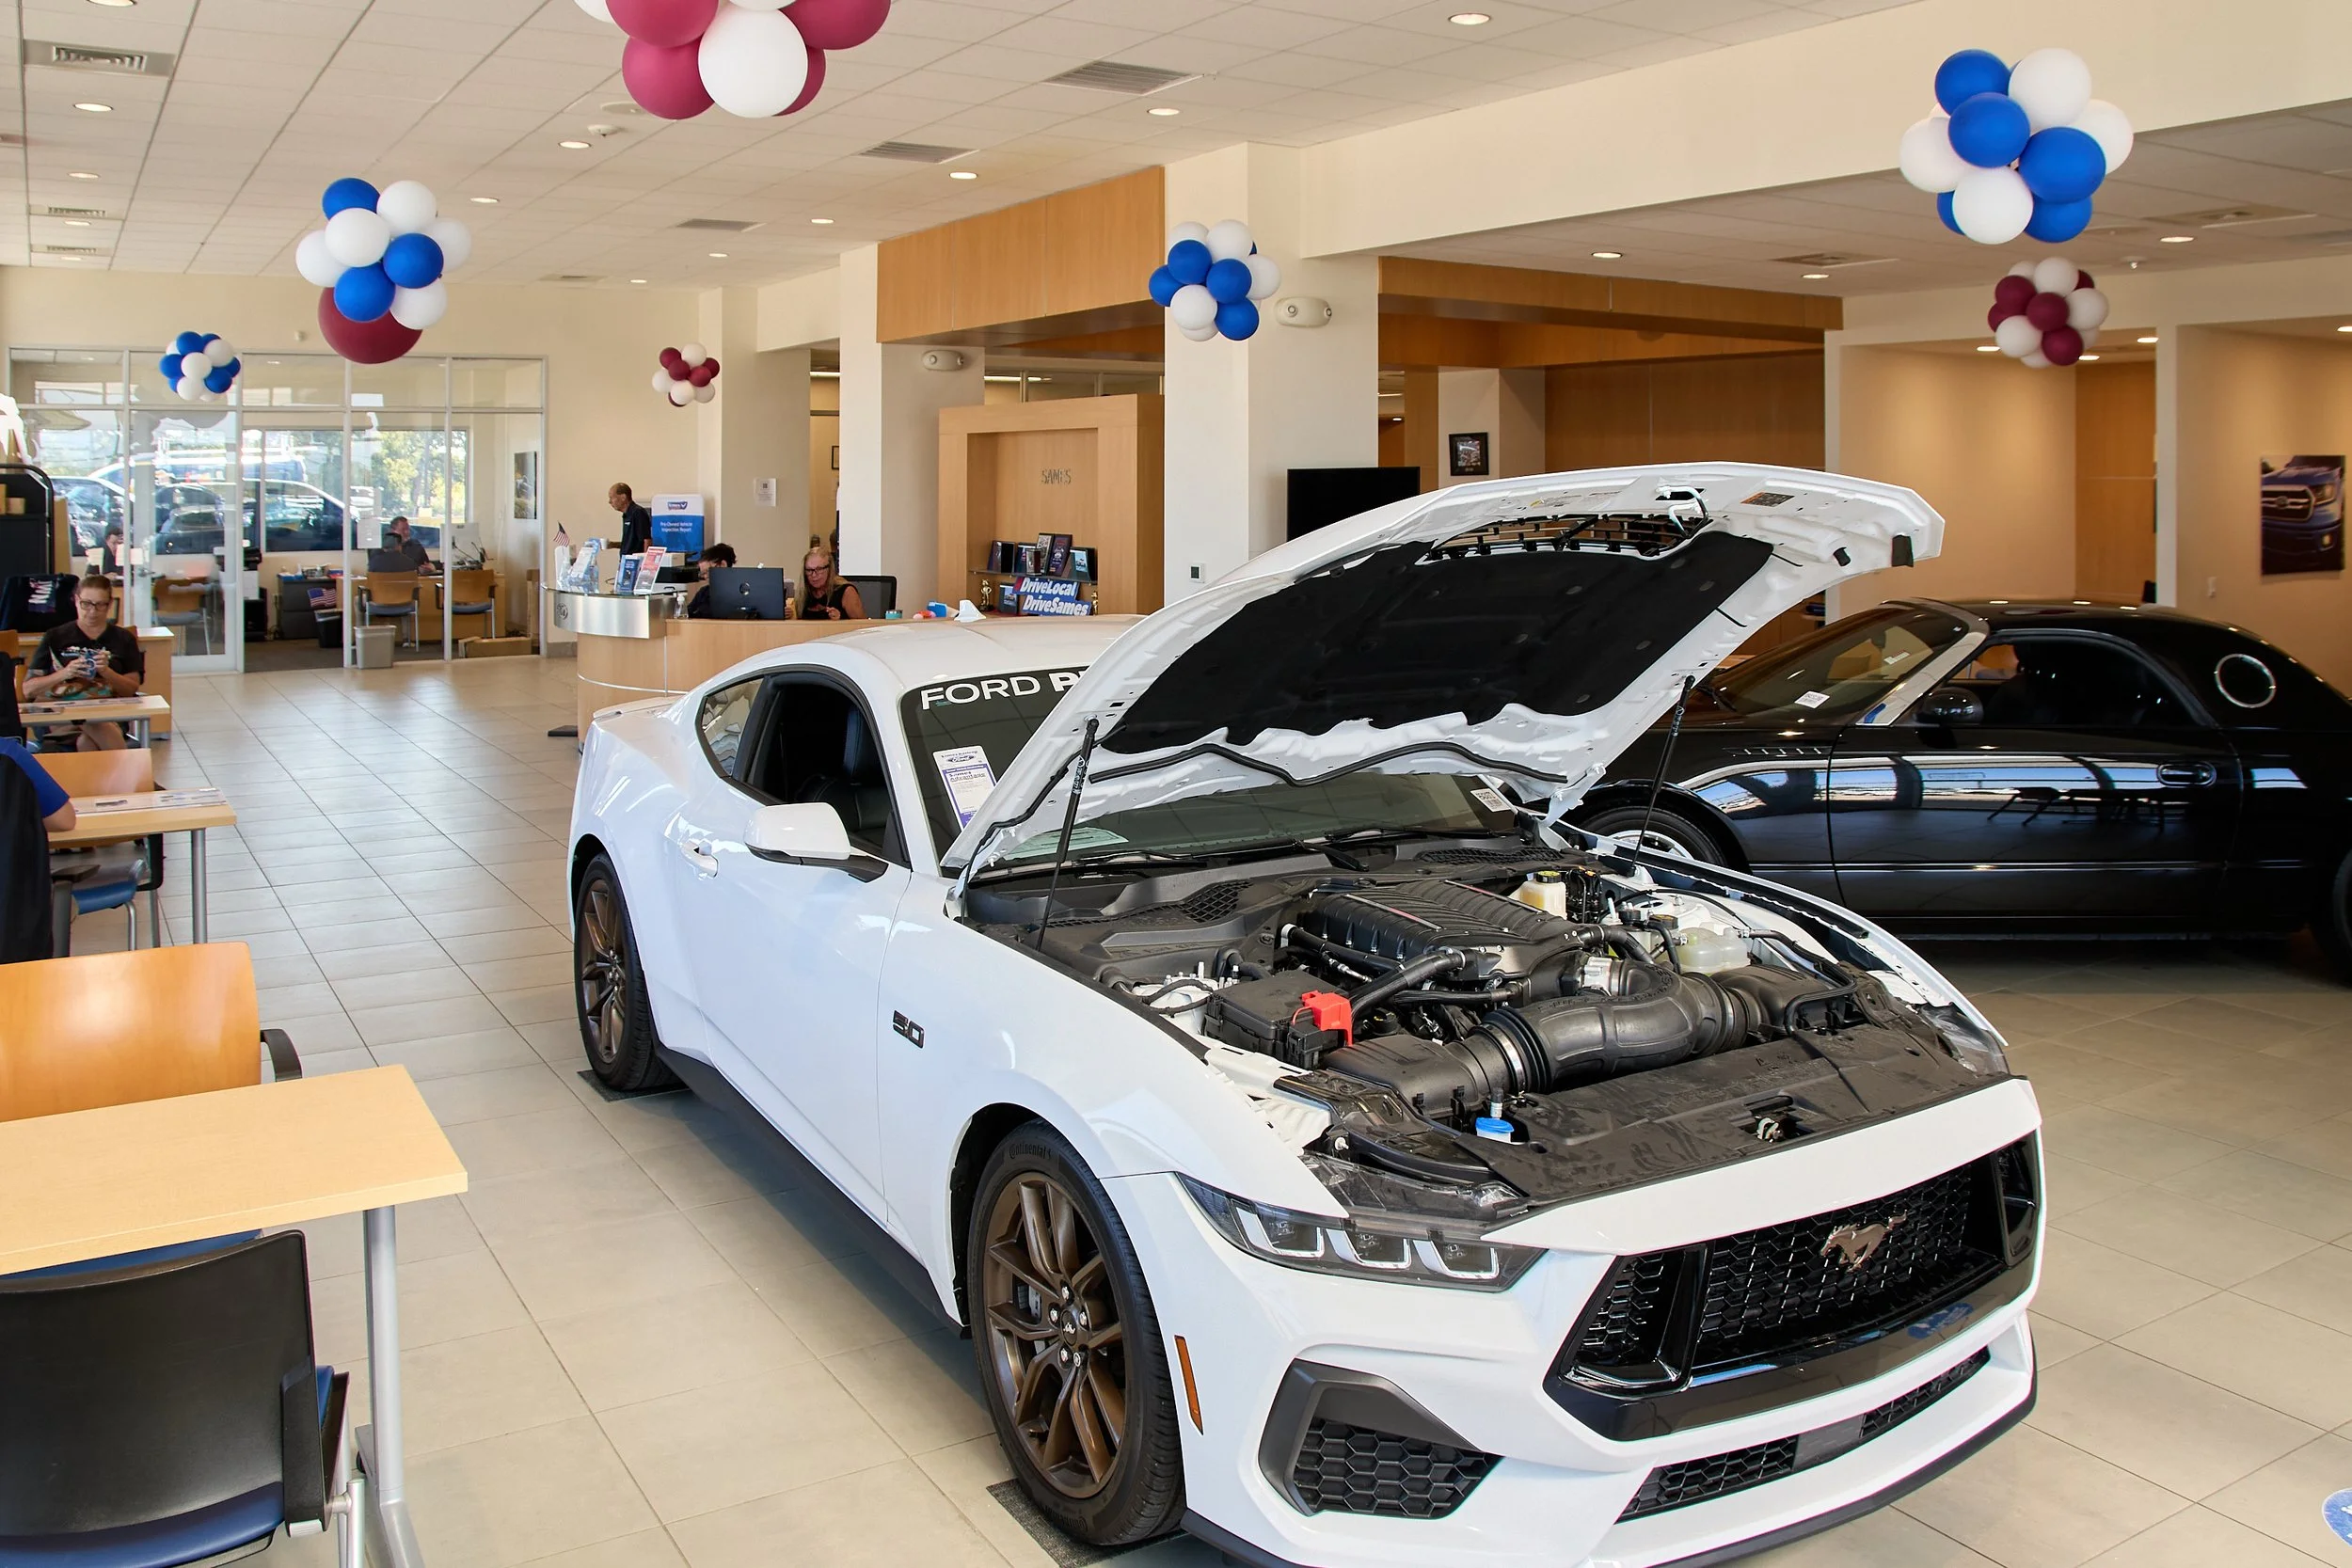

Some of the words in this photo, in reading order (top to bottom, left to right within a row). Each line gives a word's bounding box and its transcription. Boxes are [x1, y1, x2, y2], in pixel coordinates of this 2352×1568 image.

[1041, 469, 1072, 484] SAMES
[1020, 577, 1077, 597] DriveLocal
[1023, 594, 1089, 616] DriveSames
[920, 675, 1041, 710] FORD
